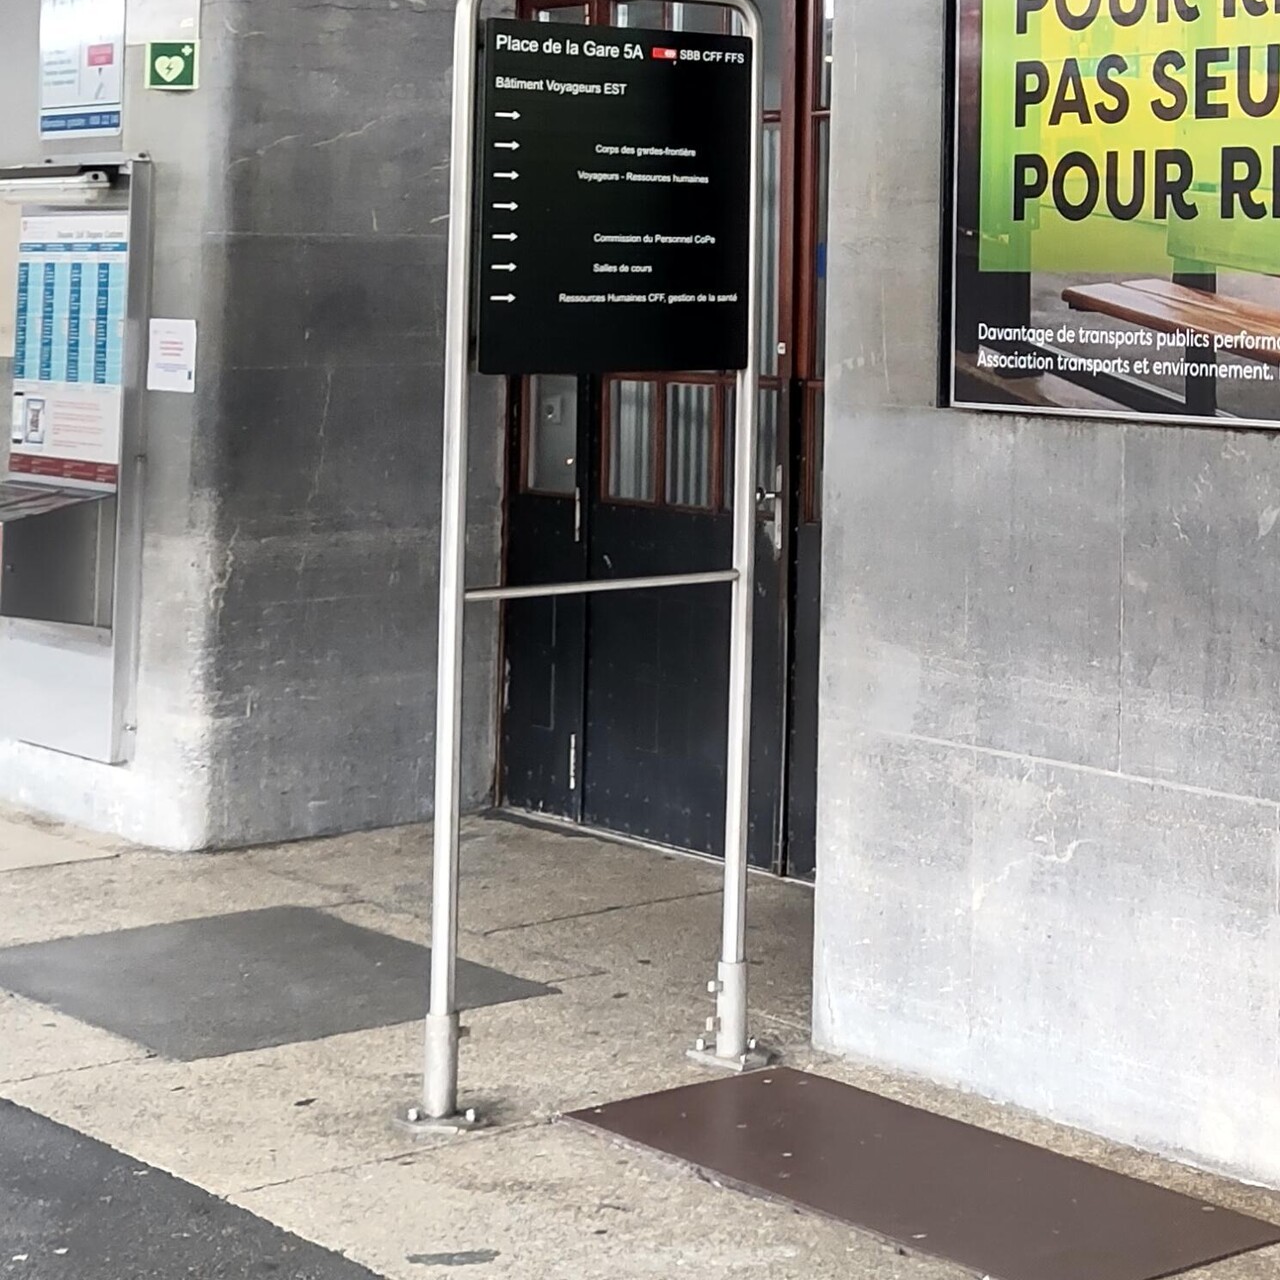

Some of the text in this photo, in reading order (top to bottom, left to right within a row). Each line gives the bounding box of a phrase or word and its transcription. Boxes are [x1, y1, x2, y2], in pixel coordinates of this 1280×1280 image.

[495, 33, 644, 60] Place de la Gare 5A
[679, 49, 745, 64] SBB CFF FFS
[495, 76, 628, 96] Bâtiment Voyageurs EST
[1015, 52, 1131, 128] PAS
[595, 143, 620, 155] Corps
[620, 145, 636, 155] des
[577, 169, 620, 182] Voyageurs
[626, 171, 672, 183] Ressources
[672, 173, 709, 184] humaines
[1013, 149, 1199, 221] POUR
[593, 233, 642, 243] Commission
[643, 234, 654, 244] du
[654, 233, 694, 244] Personnel
[618, 263, 630, 273] de
[630, 265, 653, 273] cours
[558, 293, 738, 305] Ressources Humaines CFF, gestion de la santé
[977, 322, 1054, 347] Davantage
[1057, 324, 1076, 344] de
[1078, 326, 1153, 349] transports
[1156, 328, 1210, 351] publics
[976, 349, 1054, 370] Association
[1056, 352, 1130, 377] transports
[1132, 357, 1150, 374] et
[1152, 357, 1274, 381] environnement.
